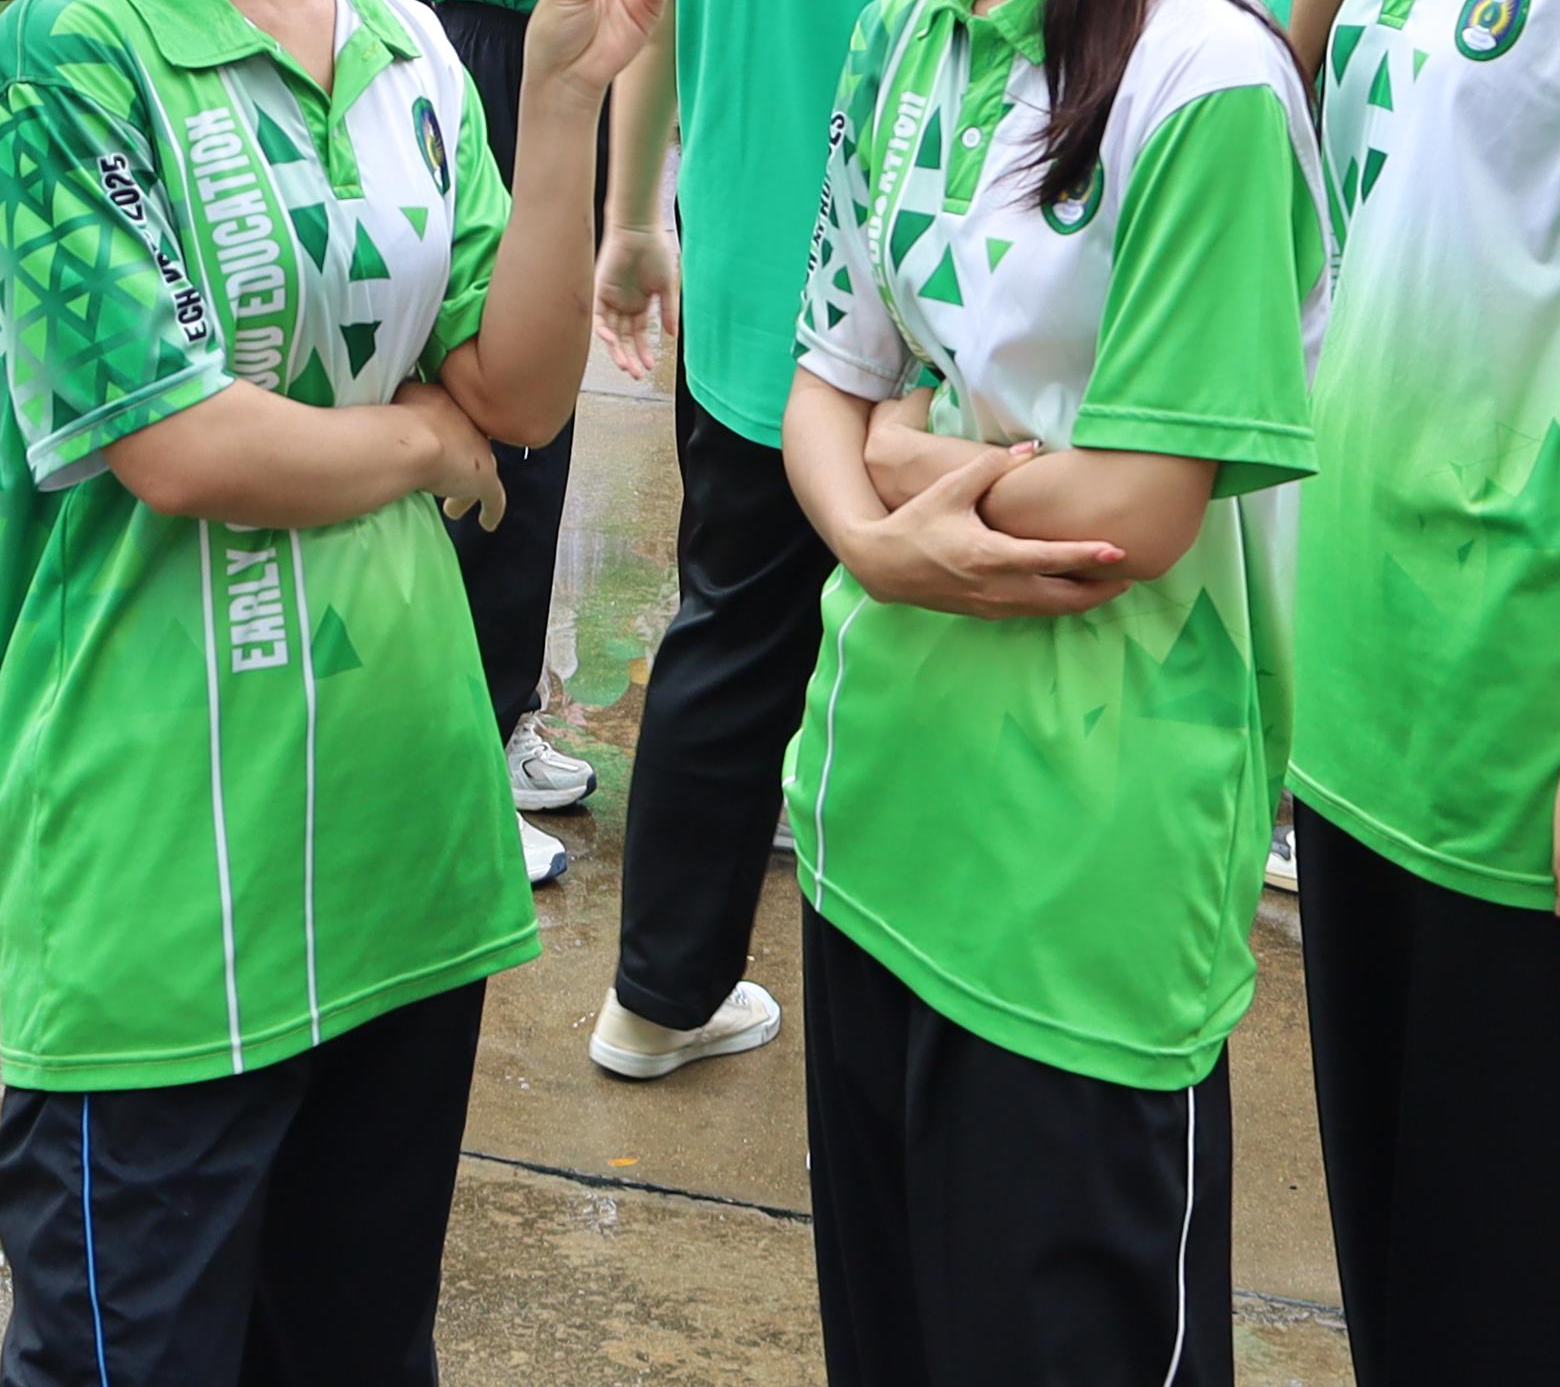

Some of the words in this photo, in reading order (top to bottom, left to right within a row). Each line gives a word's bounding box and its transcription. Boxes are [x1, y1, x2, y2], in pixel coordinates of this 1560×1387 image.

[184, 106, 286, 319] EDUCATION
[177, 290, 209, 343] ECH
[225, 546, 289, 673] EARLY
